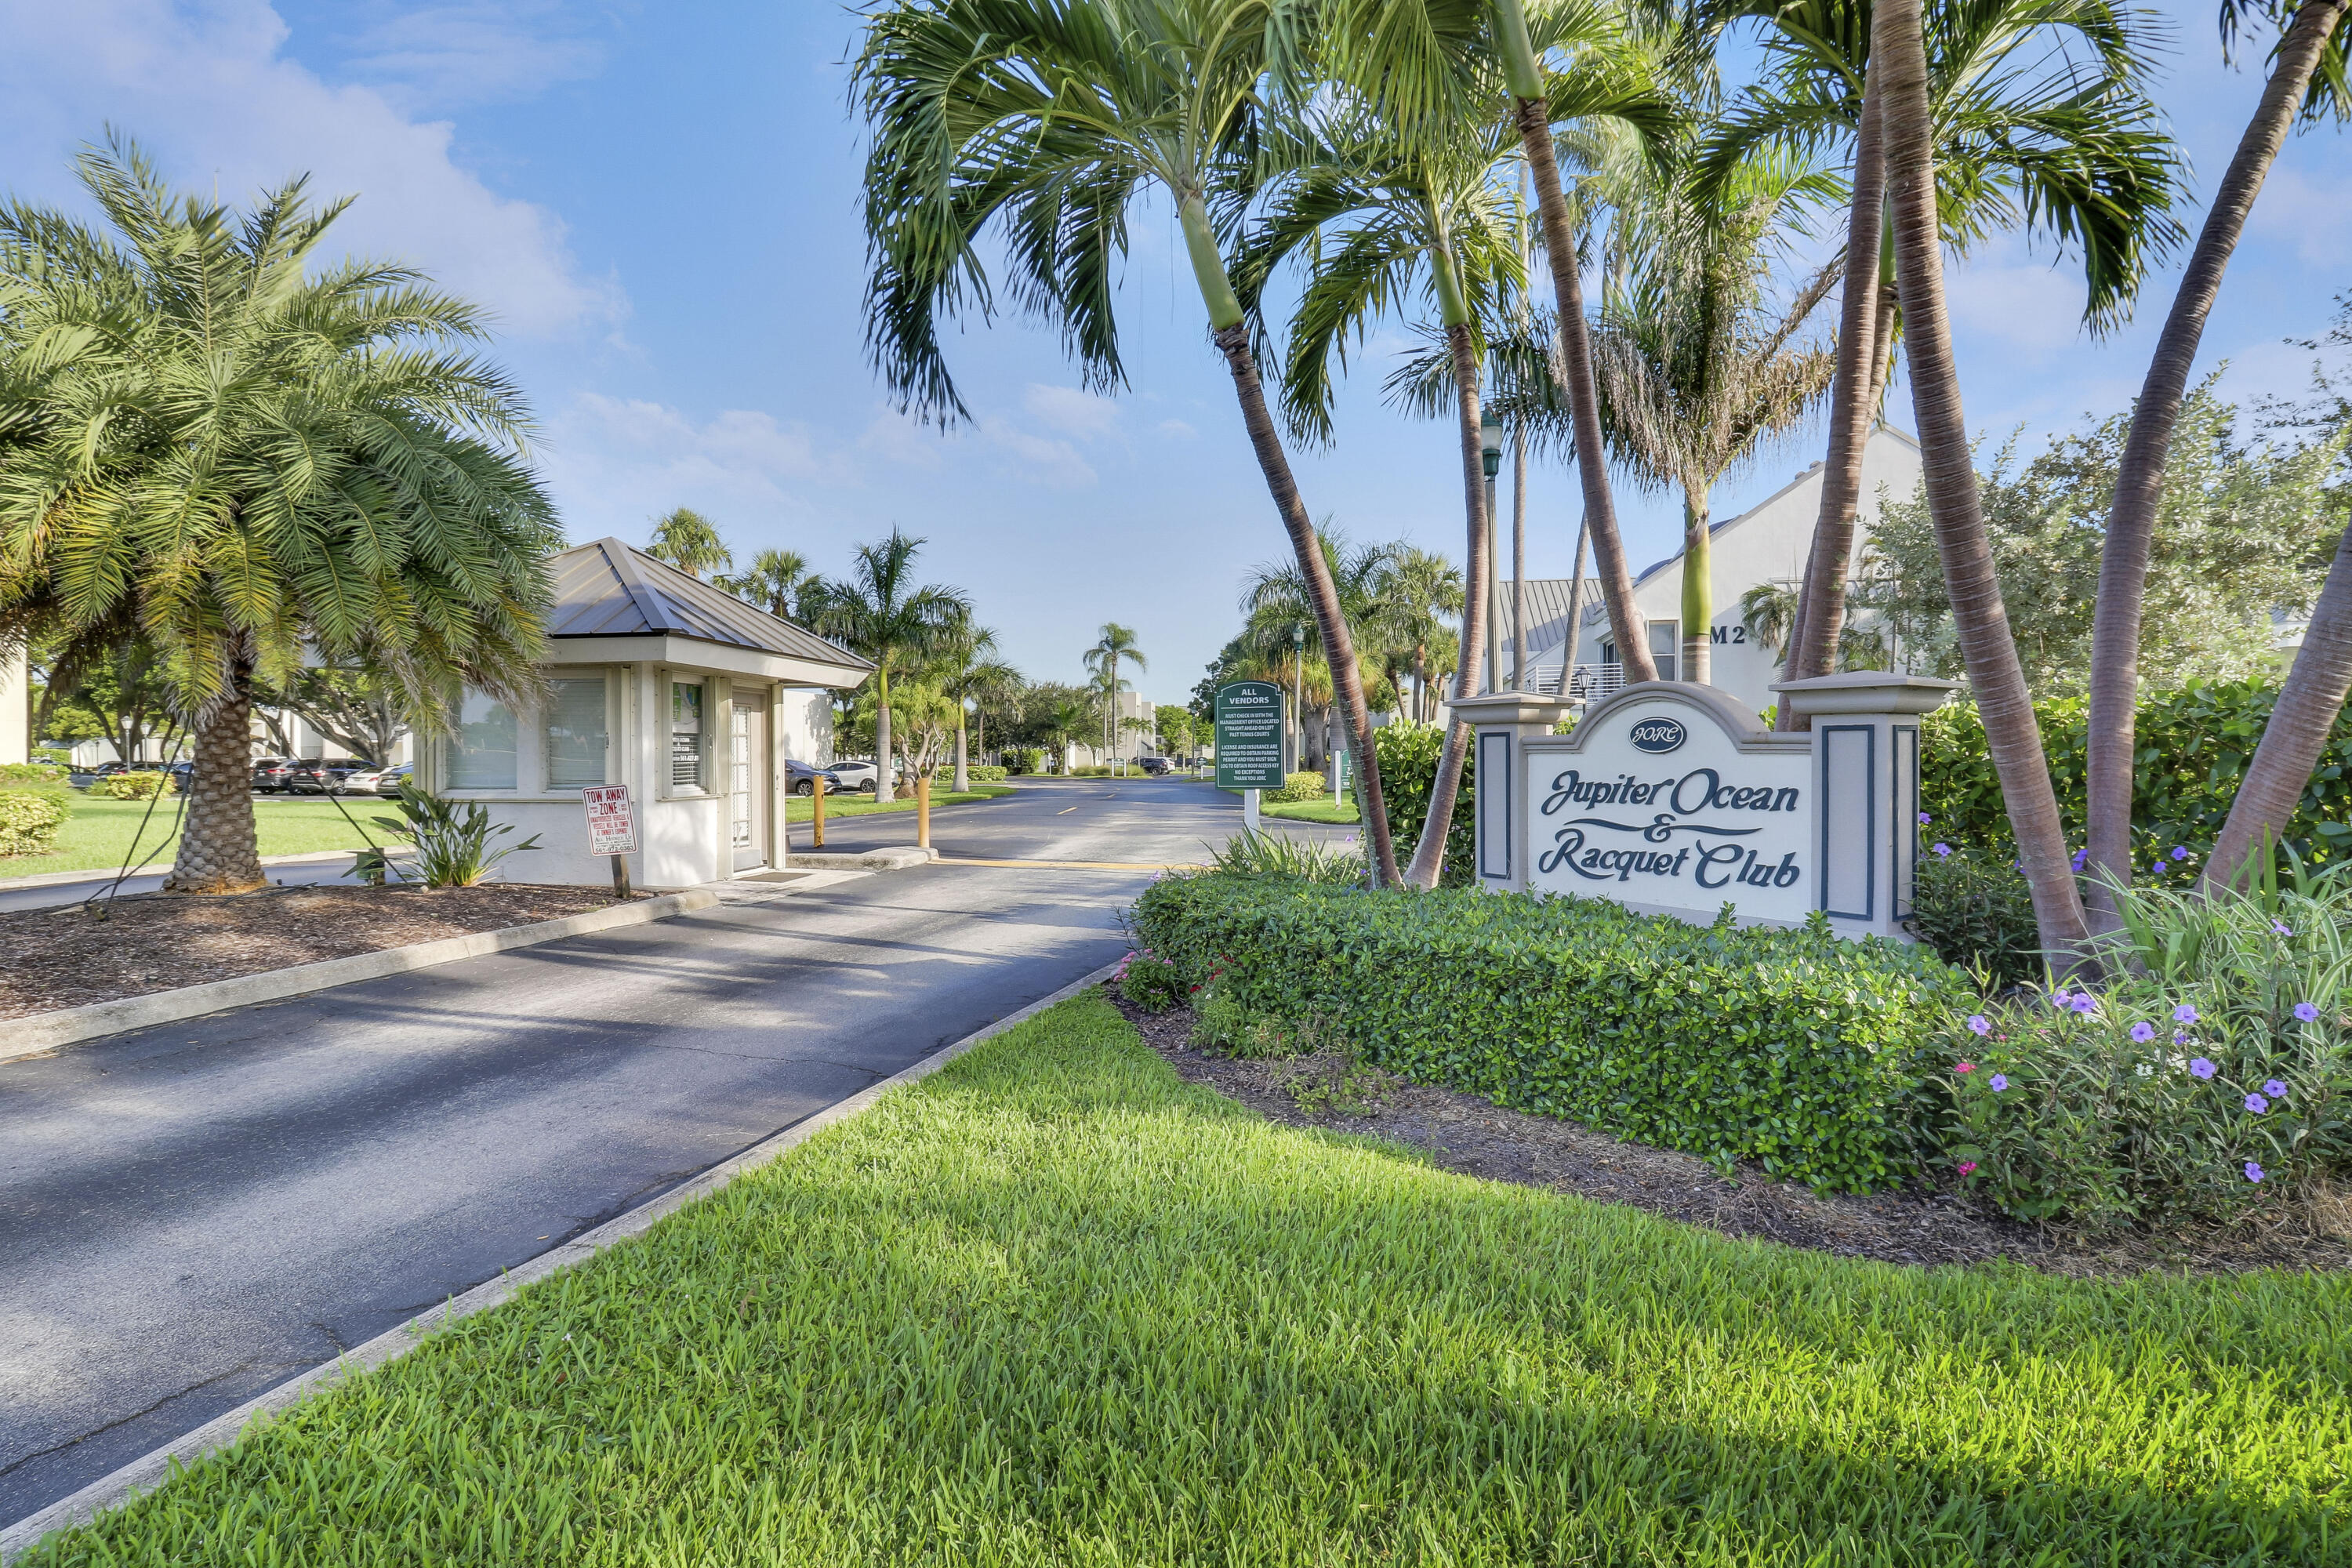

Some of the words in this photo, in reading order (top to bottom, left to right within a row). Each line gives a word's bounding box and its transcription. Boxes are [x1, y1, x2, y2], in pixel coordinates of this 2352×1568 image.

[1632, 726, 1679, 742] JORC
[586, 790, 602, 803] TOW
[606, 788, 624, 801] AWAY
[1541, 769, 1675, 816] Jupiter
[1670, 768, 1799, 815] Ocean
[599, 802, 618, 815] ZONE
[1644, 813, 1676, 843] &
[1539, 828, 1689, 881] Racquet
[1695, 839, 1800, 889] Club
